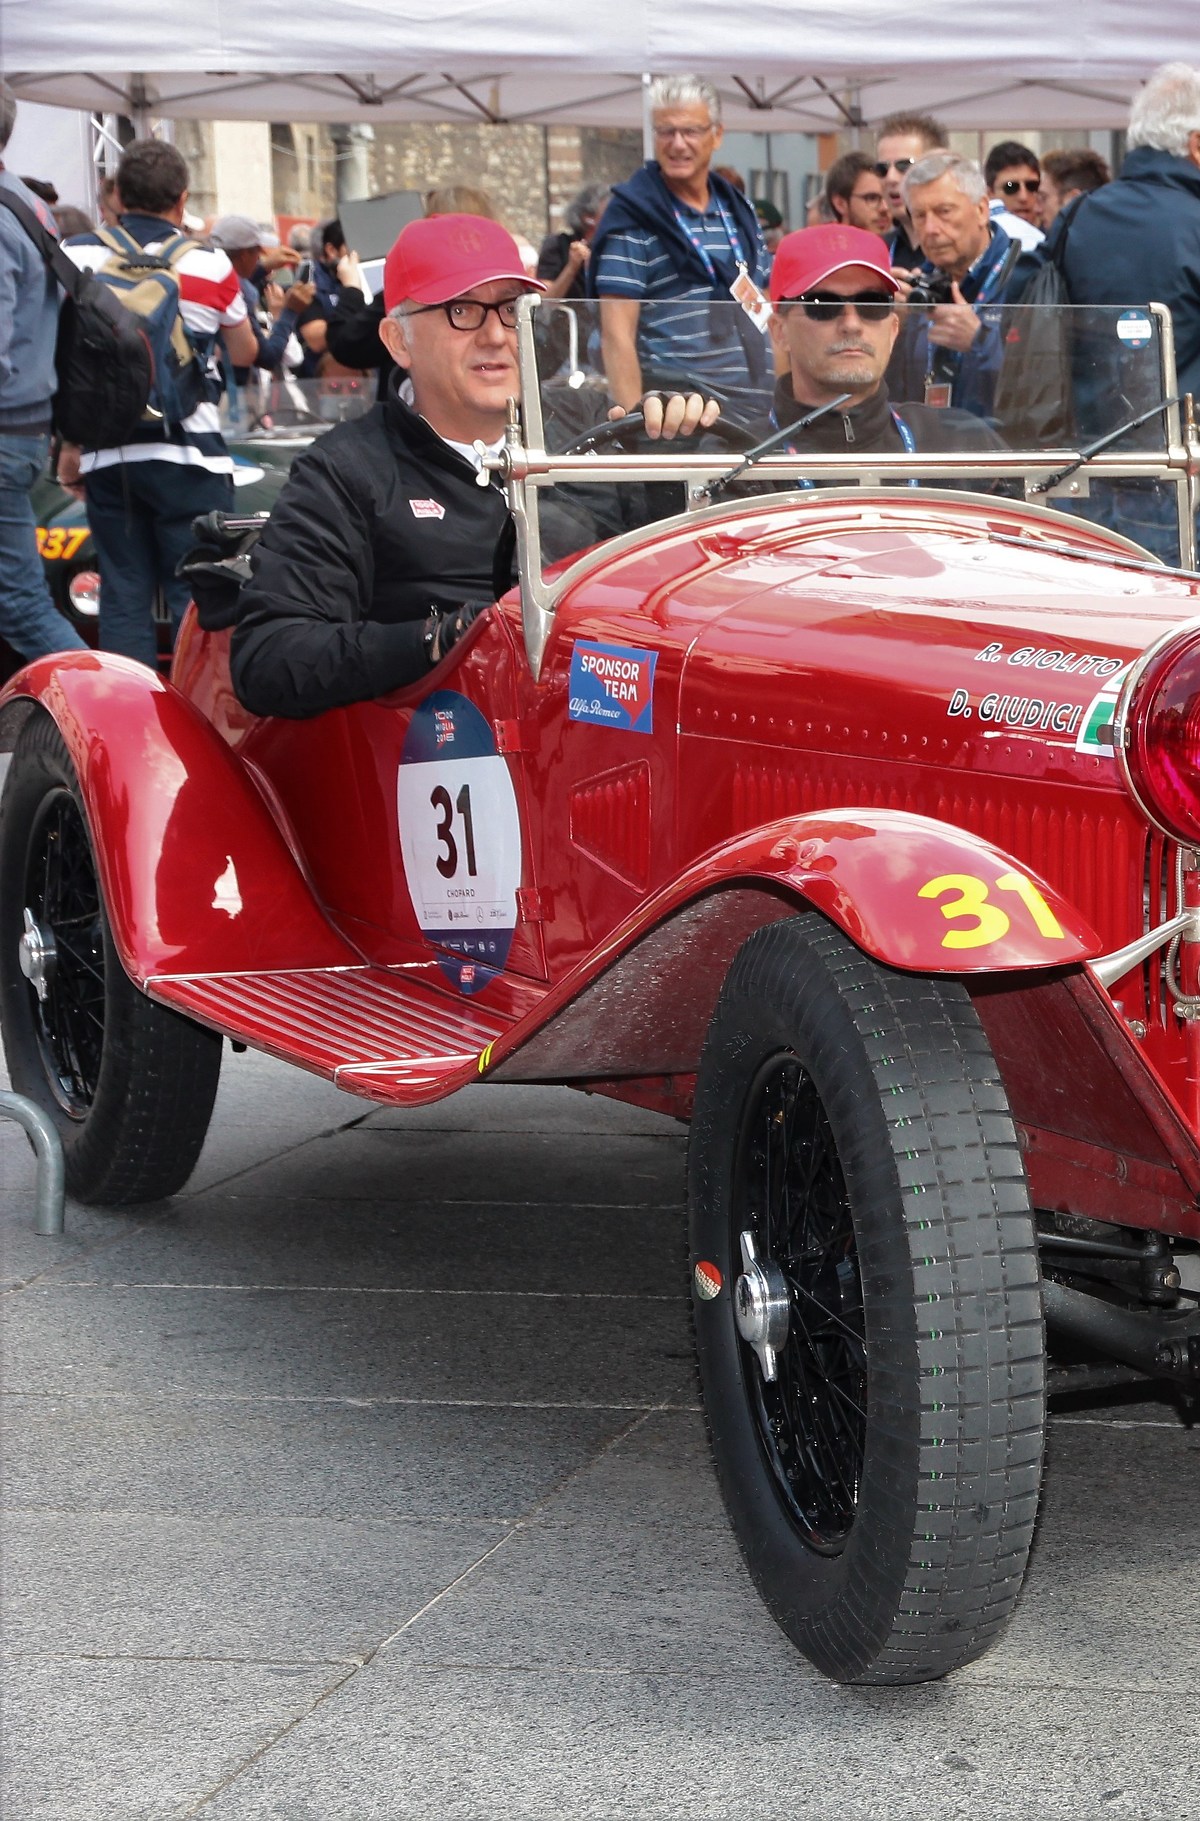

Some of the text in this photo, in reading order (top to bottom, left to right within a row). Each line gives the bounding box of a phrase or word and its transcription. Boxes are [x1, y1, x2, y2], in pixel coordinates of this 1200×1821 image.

[580, 655, 640, 681] SPONSOR
[975, 643, 1124, 678] R. GIOLITO
[569, 697, 621, 718] Alfa Romeo
[603, 679, 638, 702] TEAM
[947, 688, 1083, 734] D. GIUDICI
[430, 784, 478, 879] 31
[917, 872, 1065, 949] 31
